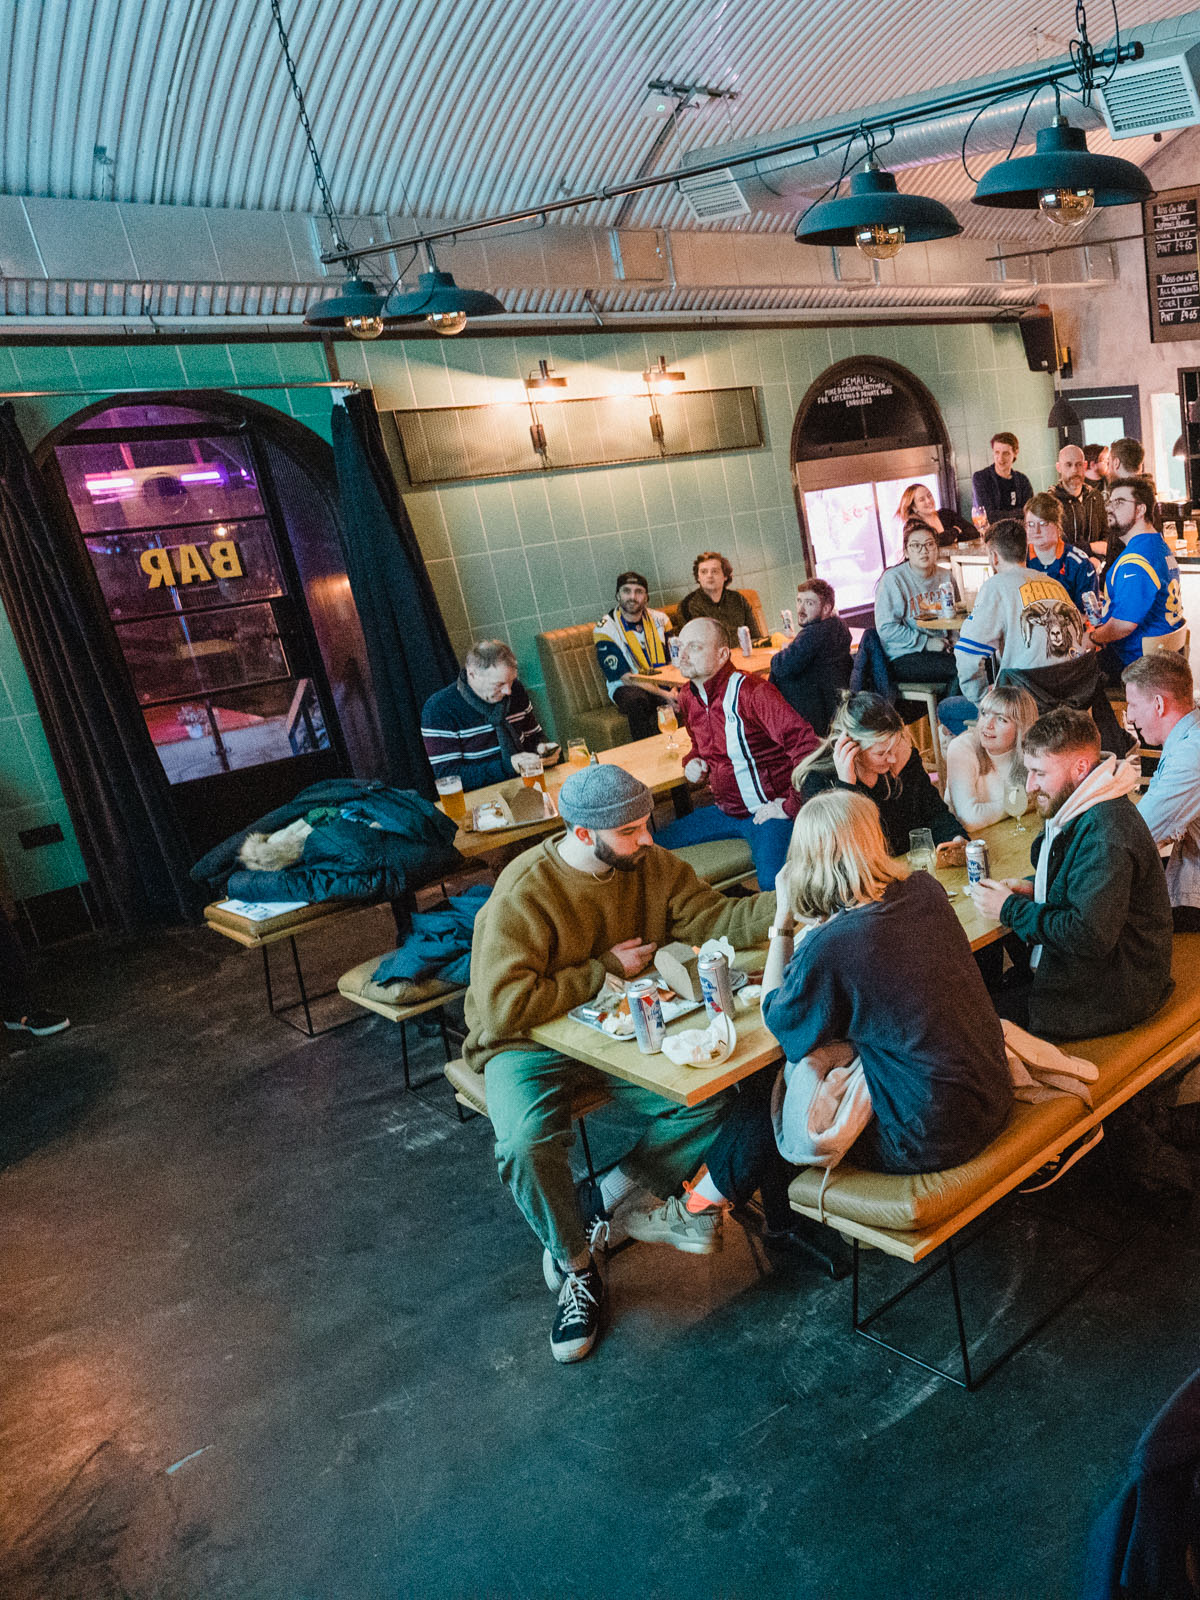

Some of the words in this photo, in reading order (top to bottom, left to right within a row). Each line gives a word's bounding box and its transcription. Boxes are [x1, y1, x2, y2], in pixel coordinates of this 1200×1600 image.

[1156, 243, 1172, 254] PINT
[1160, 287, 1171, 297] ALL
[1158, 299, 1177, 308] CIDER
[1160, 311, 1175, 323] PINT
[846, 375, 870, 387] EMAIL
